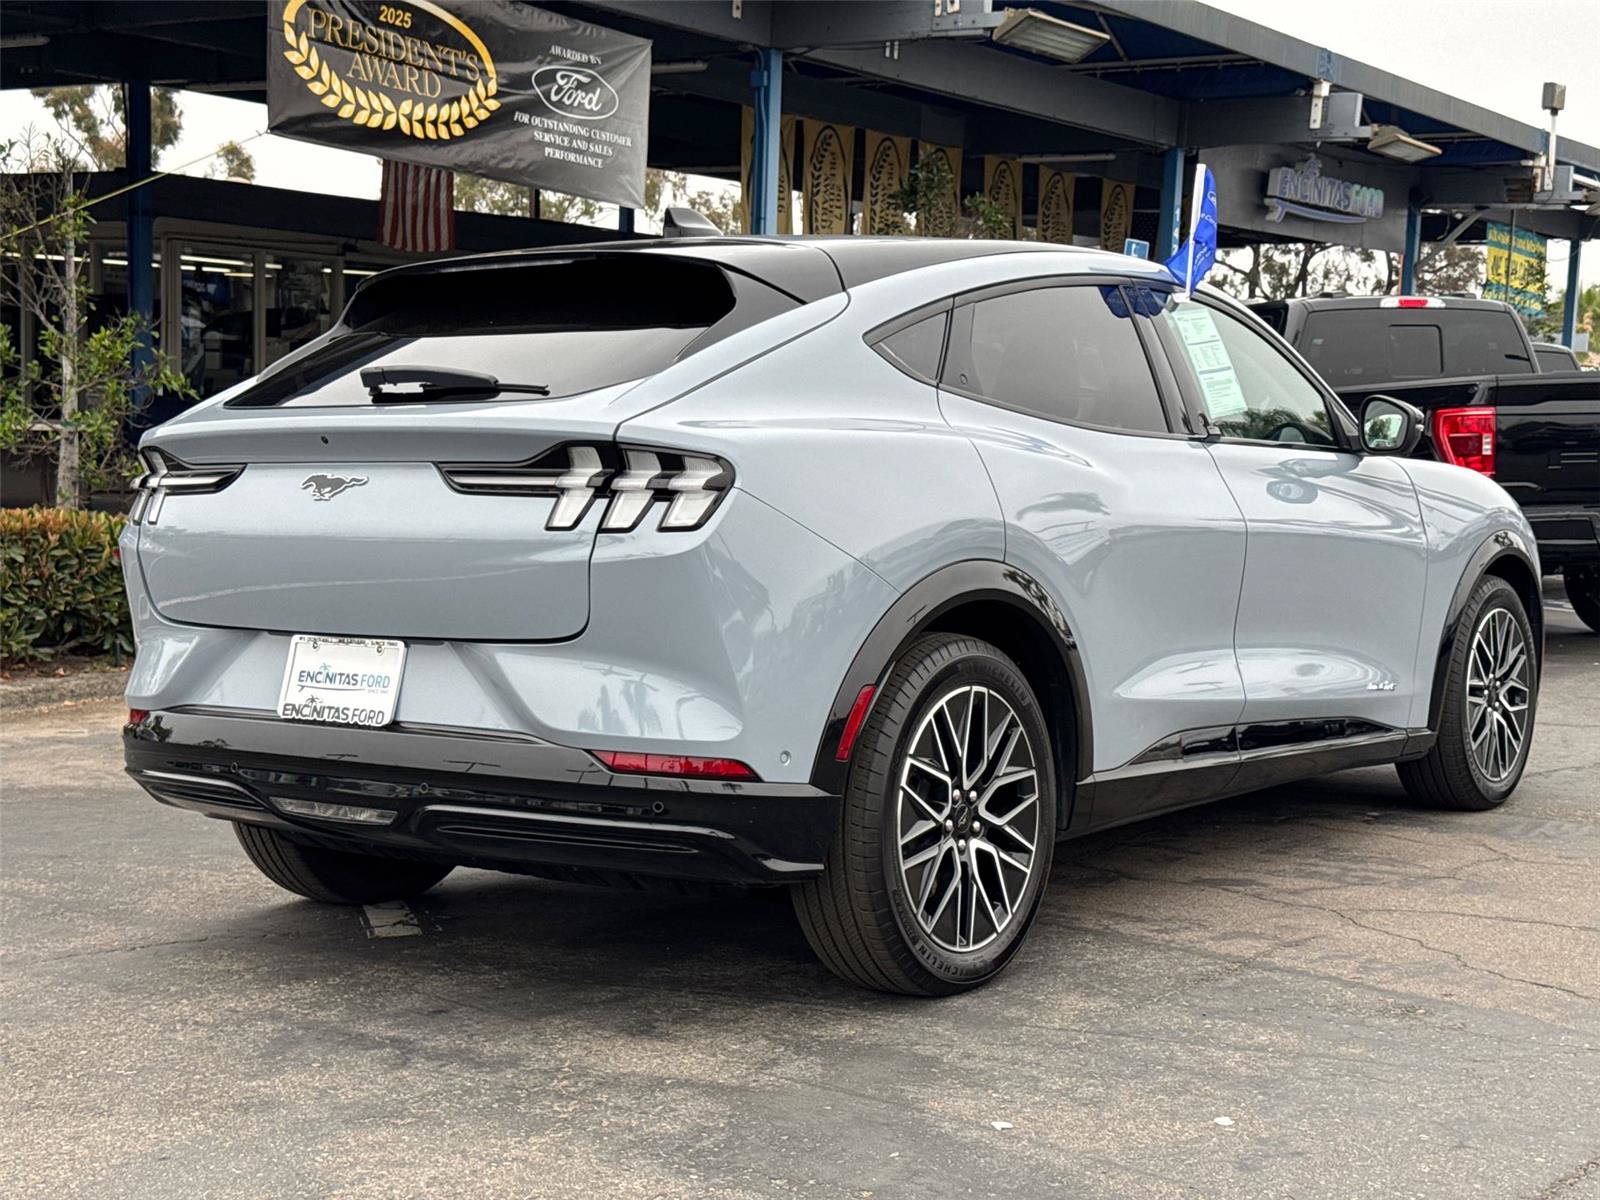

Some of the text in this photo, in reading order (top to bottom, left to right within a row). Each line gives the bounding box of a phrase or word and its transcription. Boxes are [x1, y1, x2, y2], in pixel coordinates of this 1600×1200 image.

[379, 5, 413, 29] 2025
[307, 8, 480, 81] PRESIDENT'S
[549, 45, 602, 64] AWARDED BY
[346, 52, 441, 98] AWARD
[550, 70, 602, 111] Ford
[513, 111, 632, 147] FOR OUTSTANDING CUSTOMER
[533, 130, 613, 156] SERVICE AND SALES
[544, 146, 603, 168] PERFORMANCE
[298, 670, 391, 689] ENCINITAS FORD
[282, 703, 385, 725] ENCINITAS FORD
